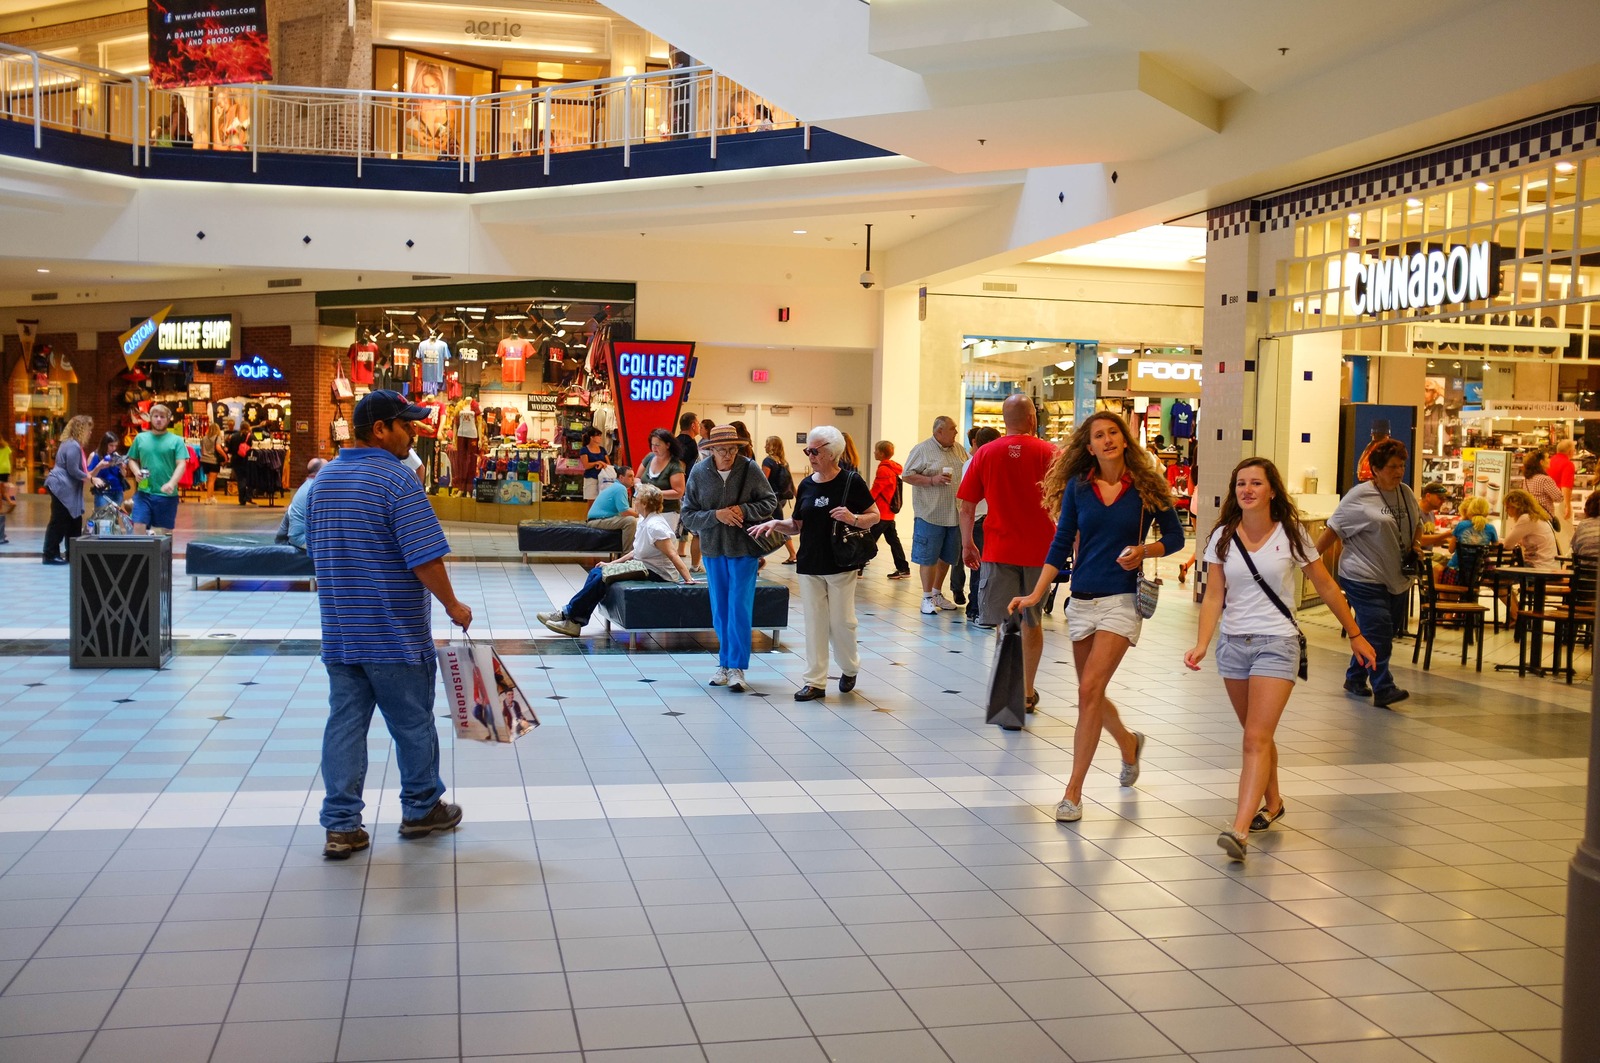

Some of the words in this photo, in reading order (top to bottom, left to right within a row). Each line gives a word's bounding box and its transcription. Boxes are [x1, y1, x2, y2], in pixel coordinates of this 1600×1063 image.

[175, 7, 256, 21] www.deankoontz.com
[174, 29, 204, 39] BANTAM
[207, 25, 257, 36] HARDCOVER
[464, 17, 522, 38] aerie
[188, 39, 203, 47] AND
[206, 36, 234, 45] eBOOK
[123, 320, 157, 355] CUSTOM
[158, 323, 201, 350] COLLEGE
[201, 320, 232, 350] SHOP
[234, 364, 269, 378] YOUR
[619, 352, 686, 378] COLLEGE
[753, 370, 768, 382] EXIT
[630, 378, 675, 402] SHOP
[528, 394, 558, 403] MINNESOT
